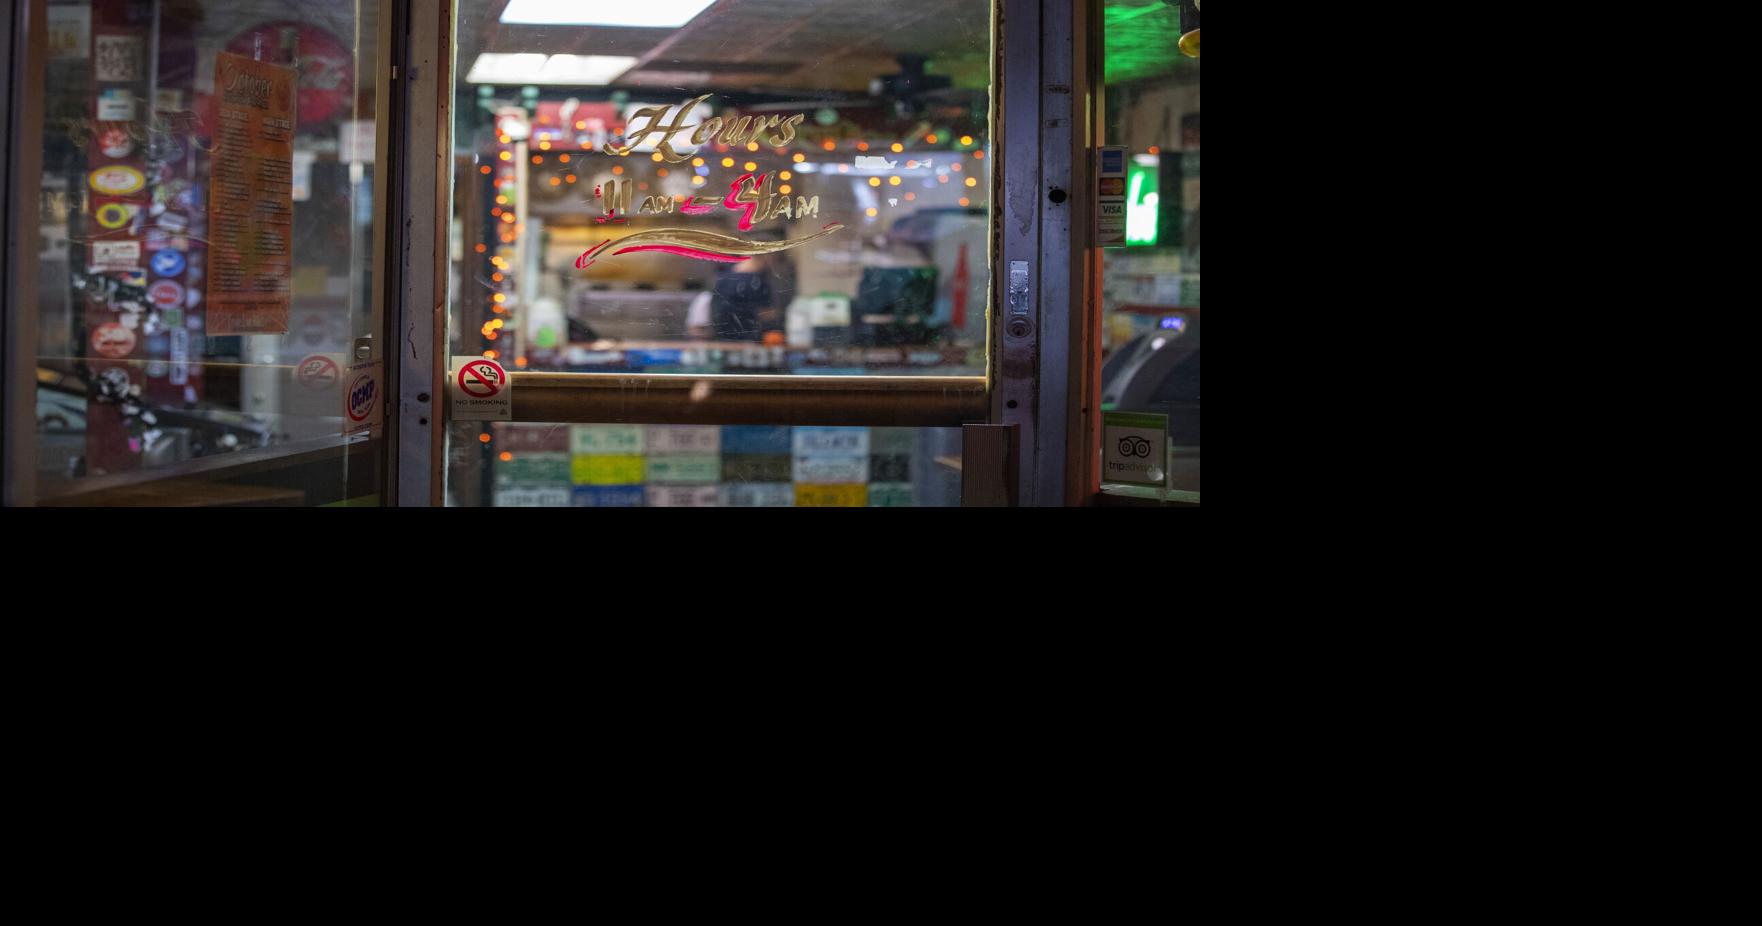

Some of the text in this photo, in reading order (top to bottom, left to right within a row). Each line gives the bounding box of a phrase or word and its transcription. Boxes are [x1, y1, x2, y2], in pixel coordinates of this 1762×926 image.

[602, 93, 805, 163] Hours
[596, 178, 633, 222] 11
[637, 195, 675, 214] AM
[725, 170, 777, 230] 4
[770, 196, 819, 220] AM
[1102, 205, 1122, 213] VISA
[351, 379, 375, 411] OCMP
